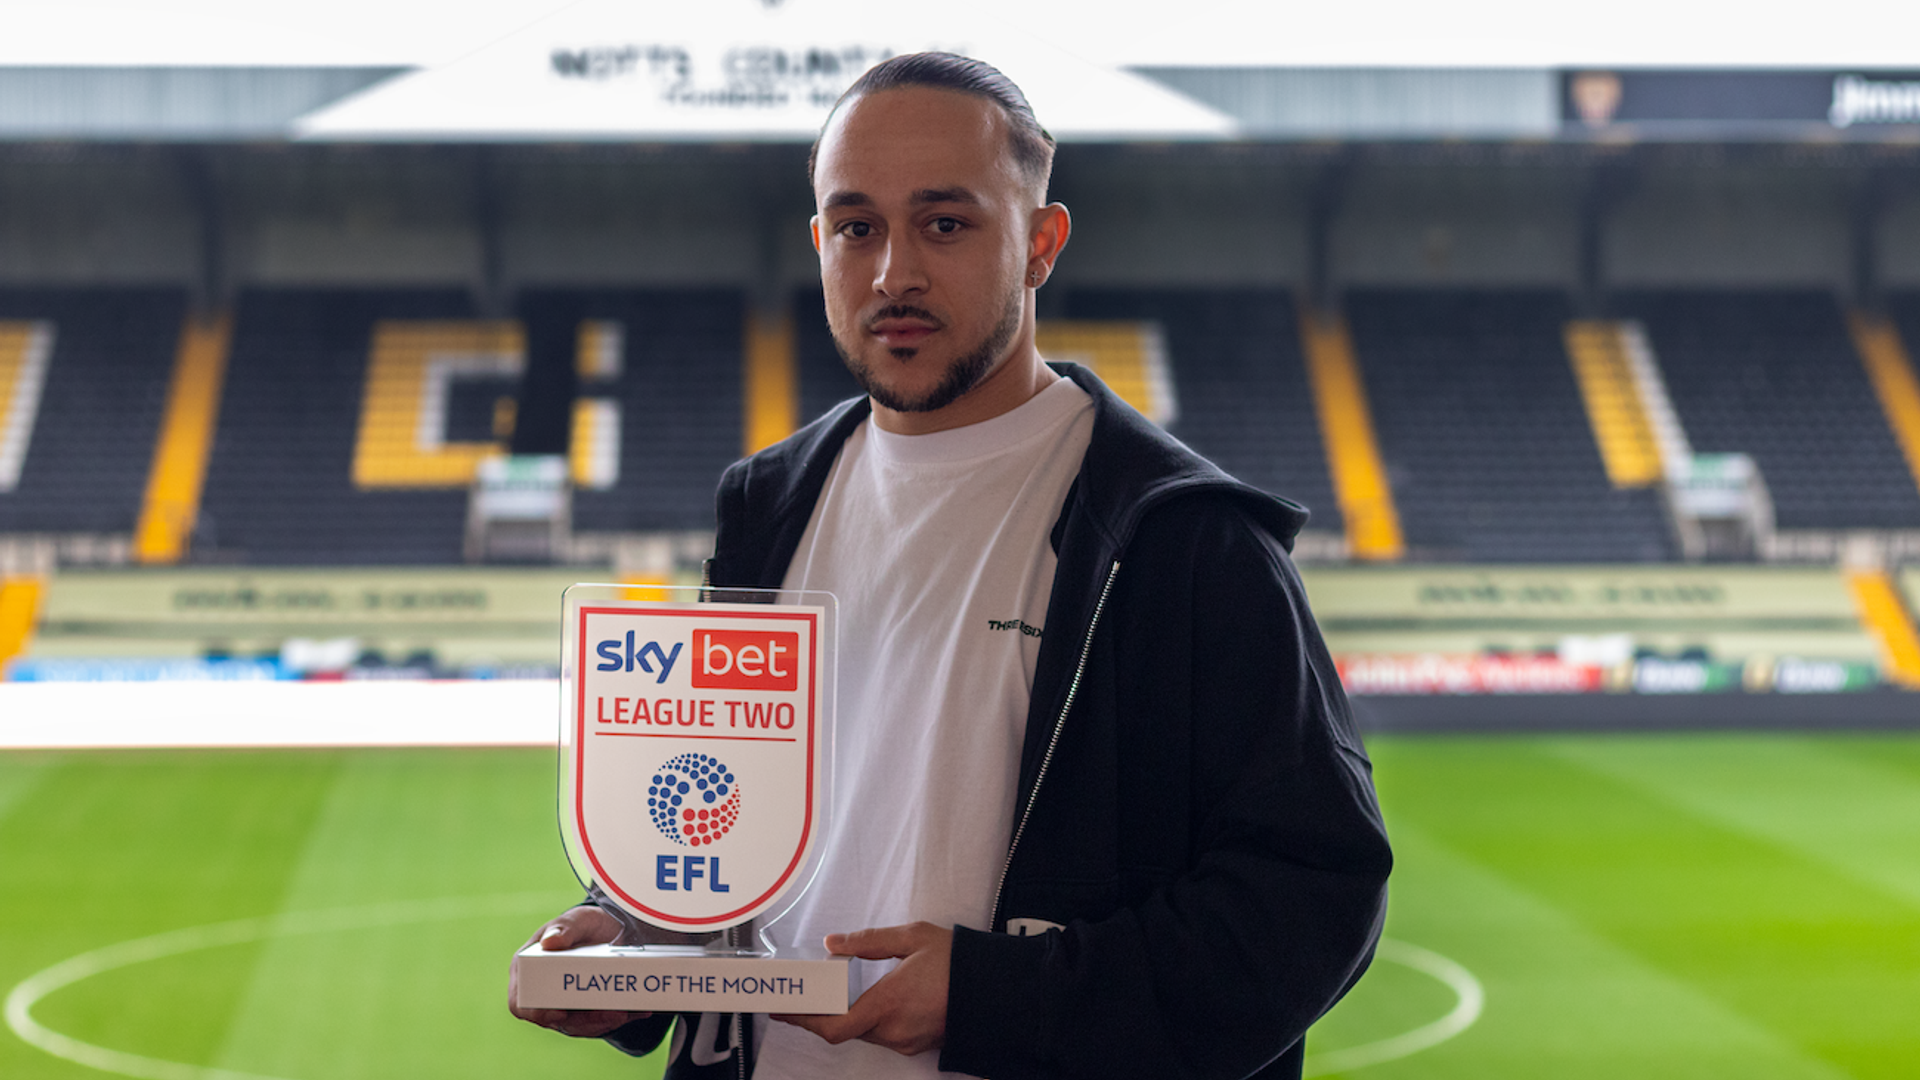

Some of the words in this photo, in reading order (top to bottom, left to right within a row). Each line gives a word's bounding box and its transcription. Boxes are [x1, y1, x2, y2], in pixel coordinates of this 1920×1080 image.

[597, 630, 684, 684] sky
[703, 634, 788, 677] bet
[597, 697, 715, 727] LEAGUE
[724, 701, 795, 730] TWO
[656, 855, 730, 893] EFL
[563, 973, 637, 992] PLAYER
[643, 975, 673, 993] OF
[676, 975, 716, 993] THE
[722, 977, 804, 995] MONTH
